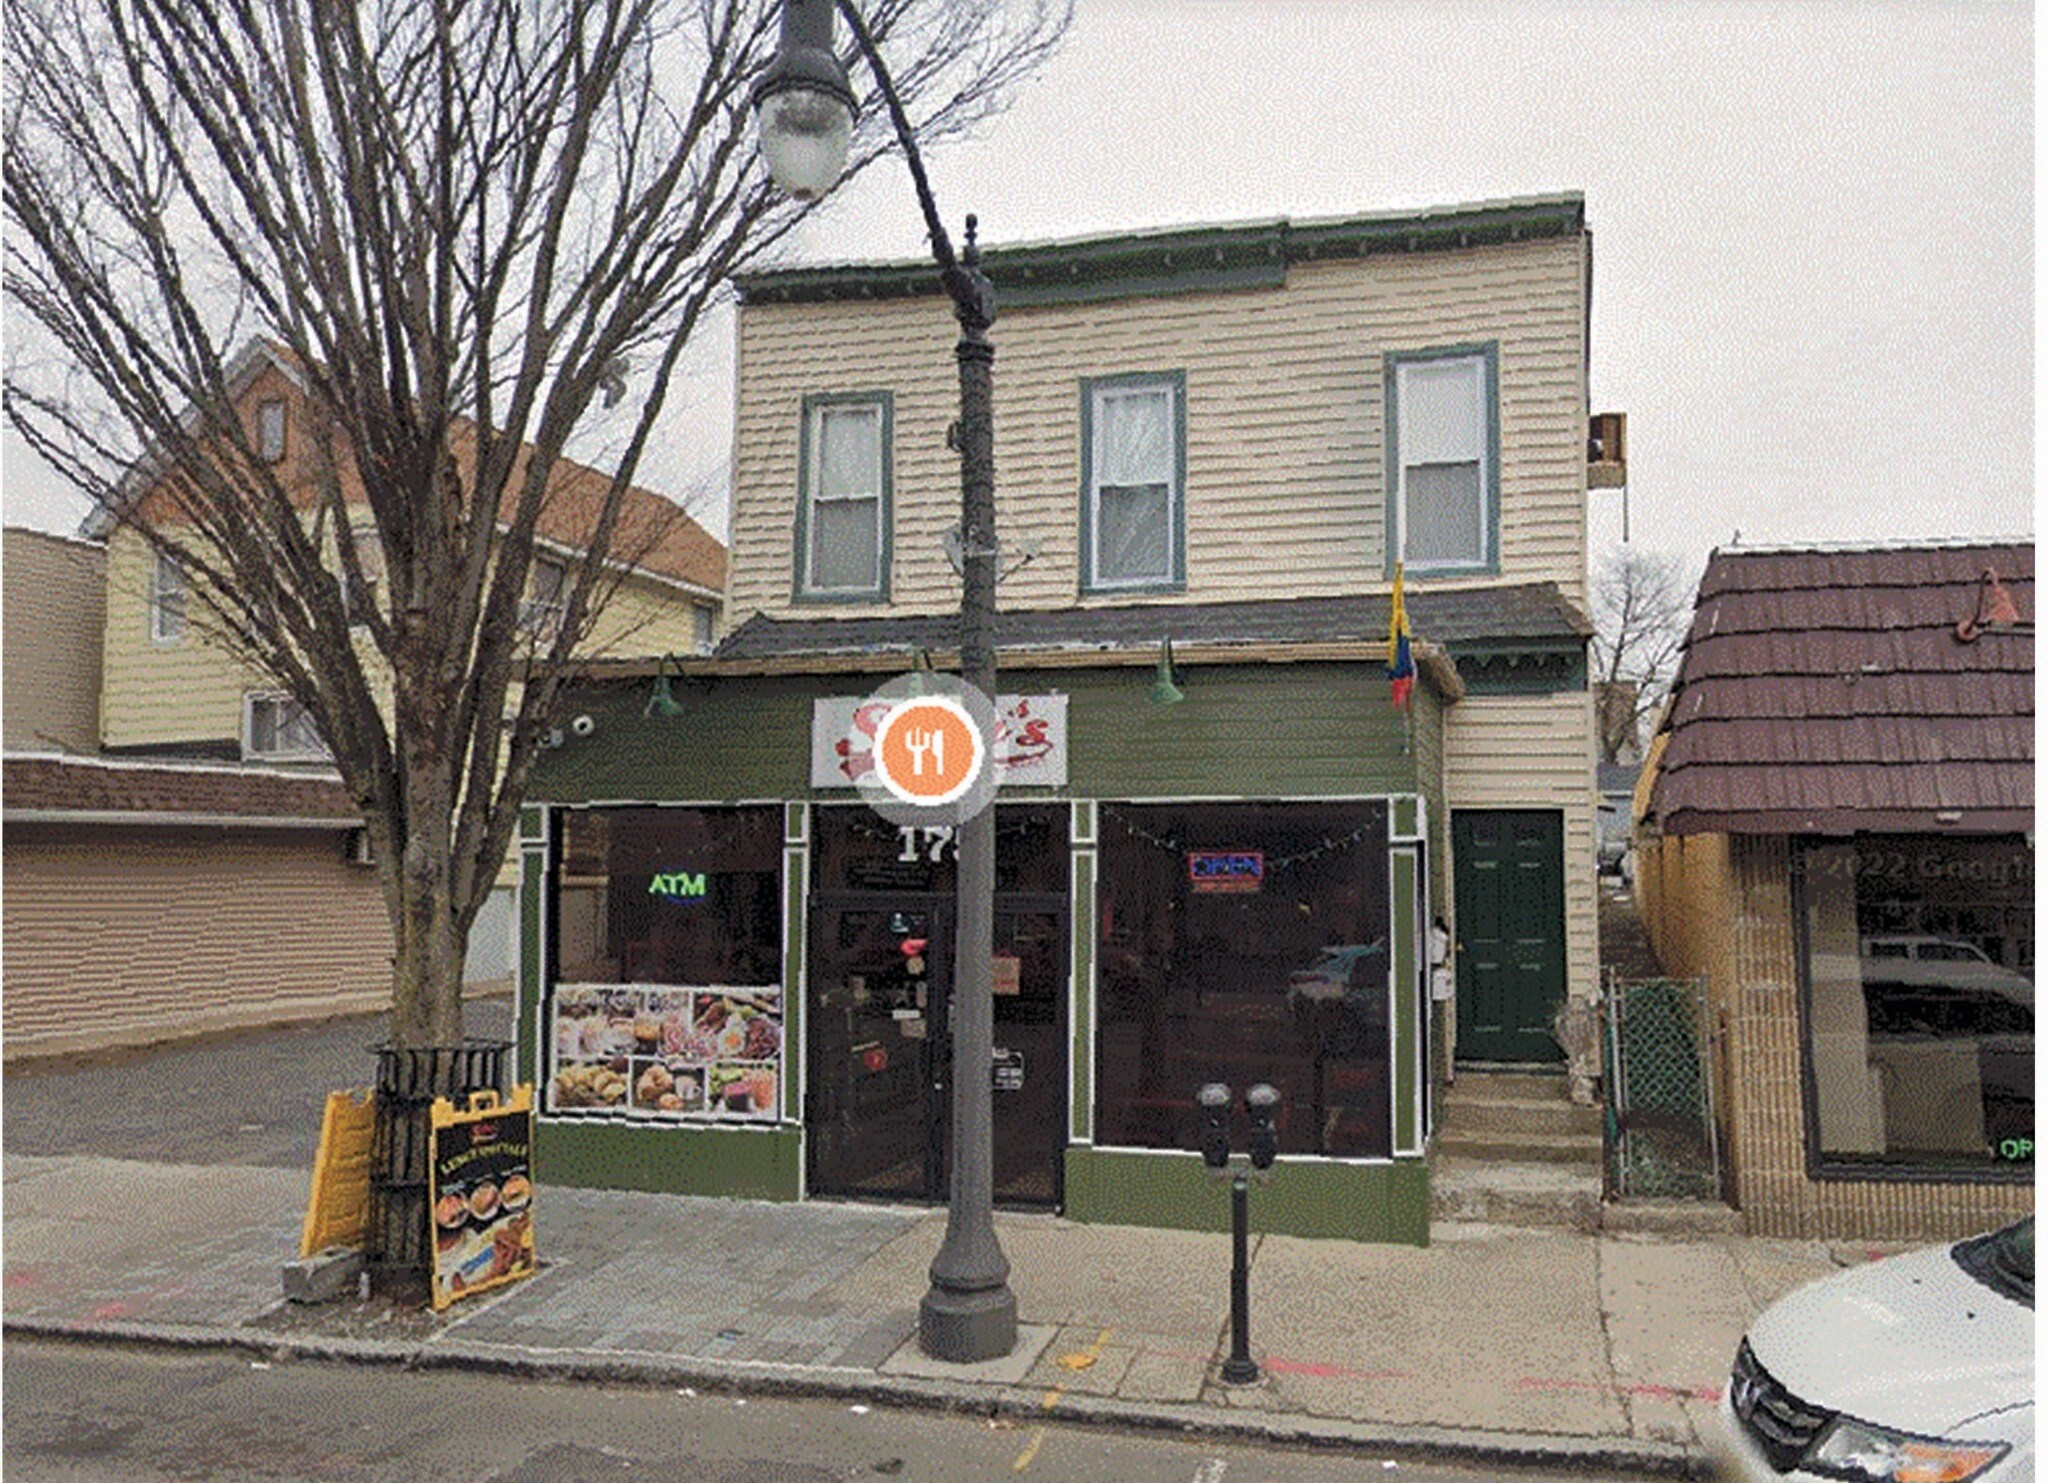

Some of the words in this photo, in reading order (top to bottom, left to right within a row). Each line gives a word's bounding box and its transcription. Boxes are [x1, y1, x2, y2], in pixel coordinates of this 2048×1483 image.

[1190, 855, 1261, 877] OPEN
[648, 871, 707, 897] ATM
[1999, 1137, 2034, 1160] OP
